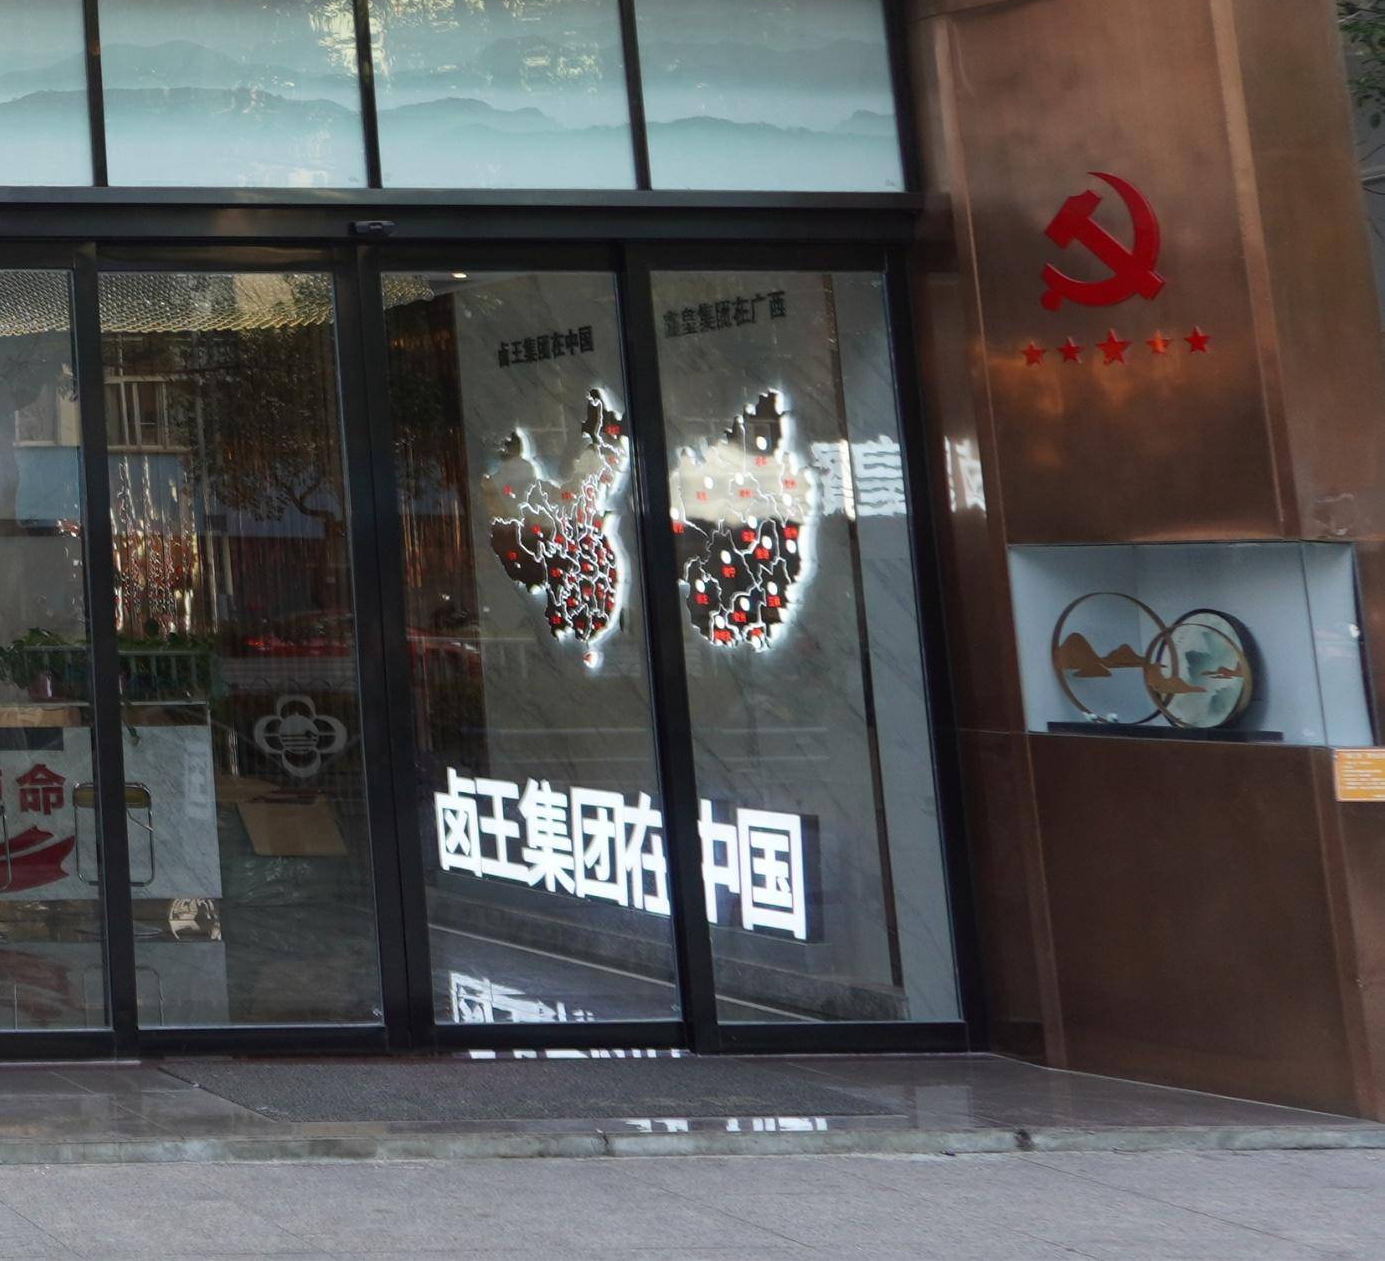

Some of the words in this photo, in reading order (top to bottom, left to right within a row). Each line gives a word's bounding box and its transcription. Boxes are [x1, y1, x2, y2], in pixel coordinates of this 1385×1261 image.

[433, 766, 808, 940] 卤王集团在中国
